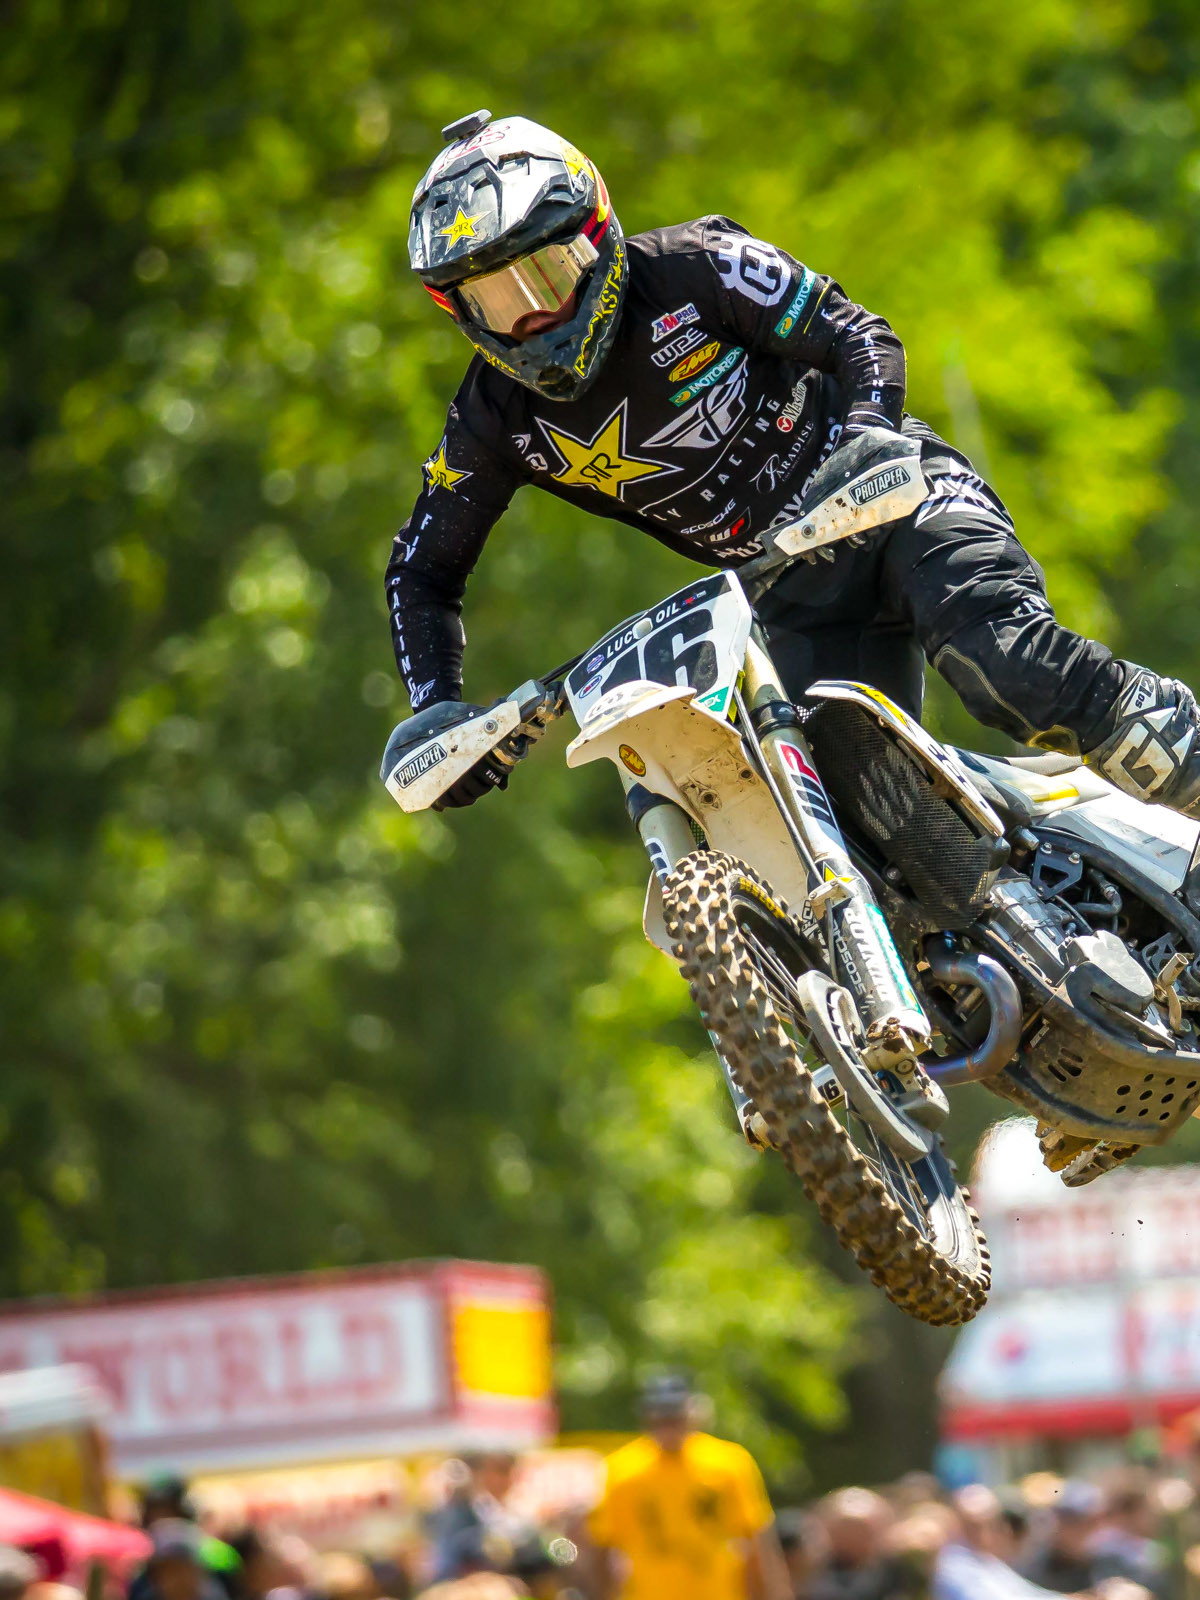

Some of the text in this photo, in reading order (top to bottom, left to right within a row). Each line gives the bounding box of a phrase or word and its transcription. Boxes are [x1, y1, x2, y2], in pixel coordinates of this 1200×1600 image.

[670, 342, 720, 382] FMF
[688, 349, 740, 393] MOTOREX
[855, 467, 904, 501] PROTAPER
[680, 498, 737, 535] SCOSCHE
[655, 602, 682, 624] OIL
[398, 744, 442, 787] PROTAPER
